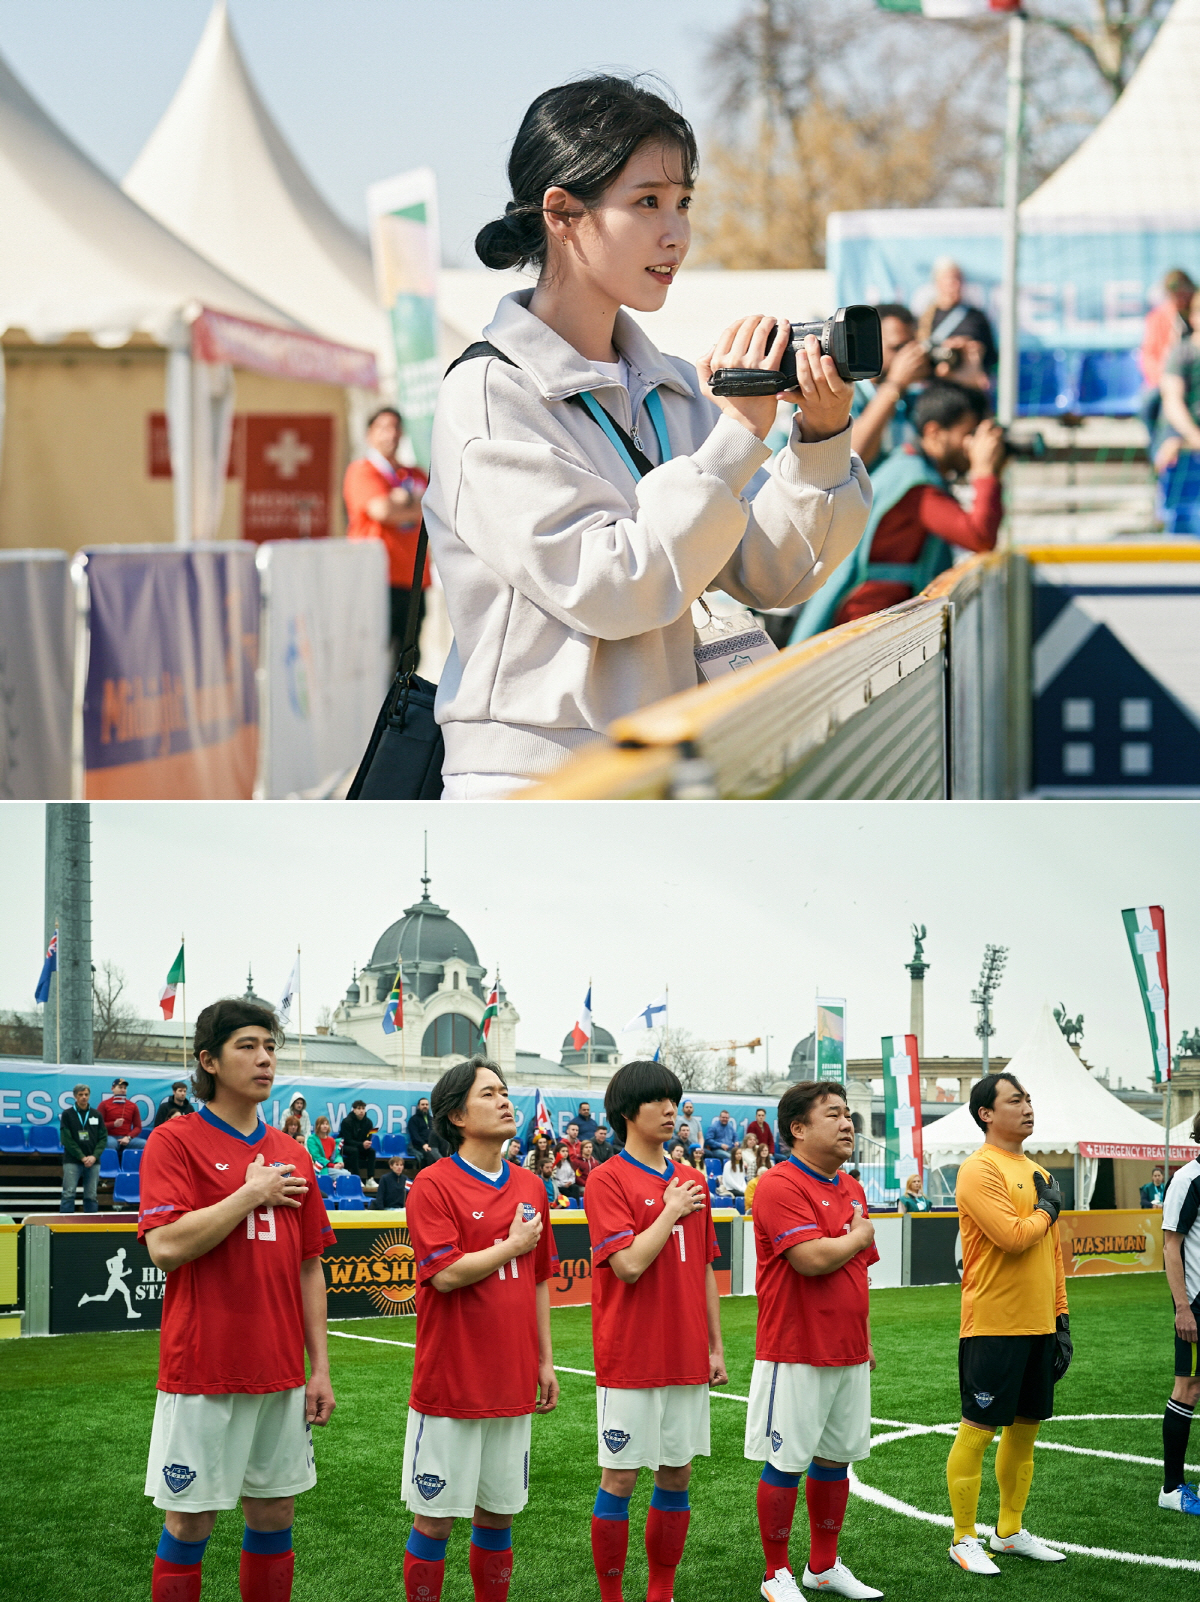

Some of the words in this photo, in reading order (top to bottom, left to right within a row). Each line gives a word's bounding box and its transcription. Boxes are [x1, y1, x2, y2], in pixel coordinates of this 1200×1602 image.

[1093, 1145, 1140, 1158] EMERGENCY
[1189, 1148, 1200, 1158] TE
[247, 1206, 276, 1241] 13
[672, 1225, 686, 1262] 7
[1072, 1235, 1146, 1256] WASHMAN
